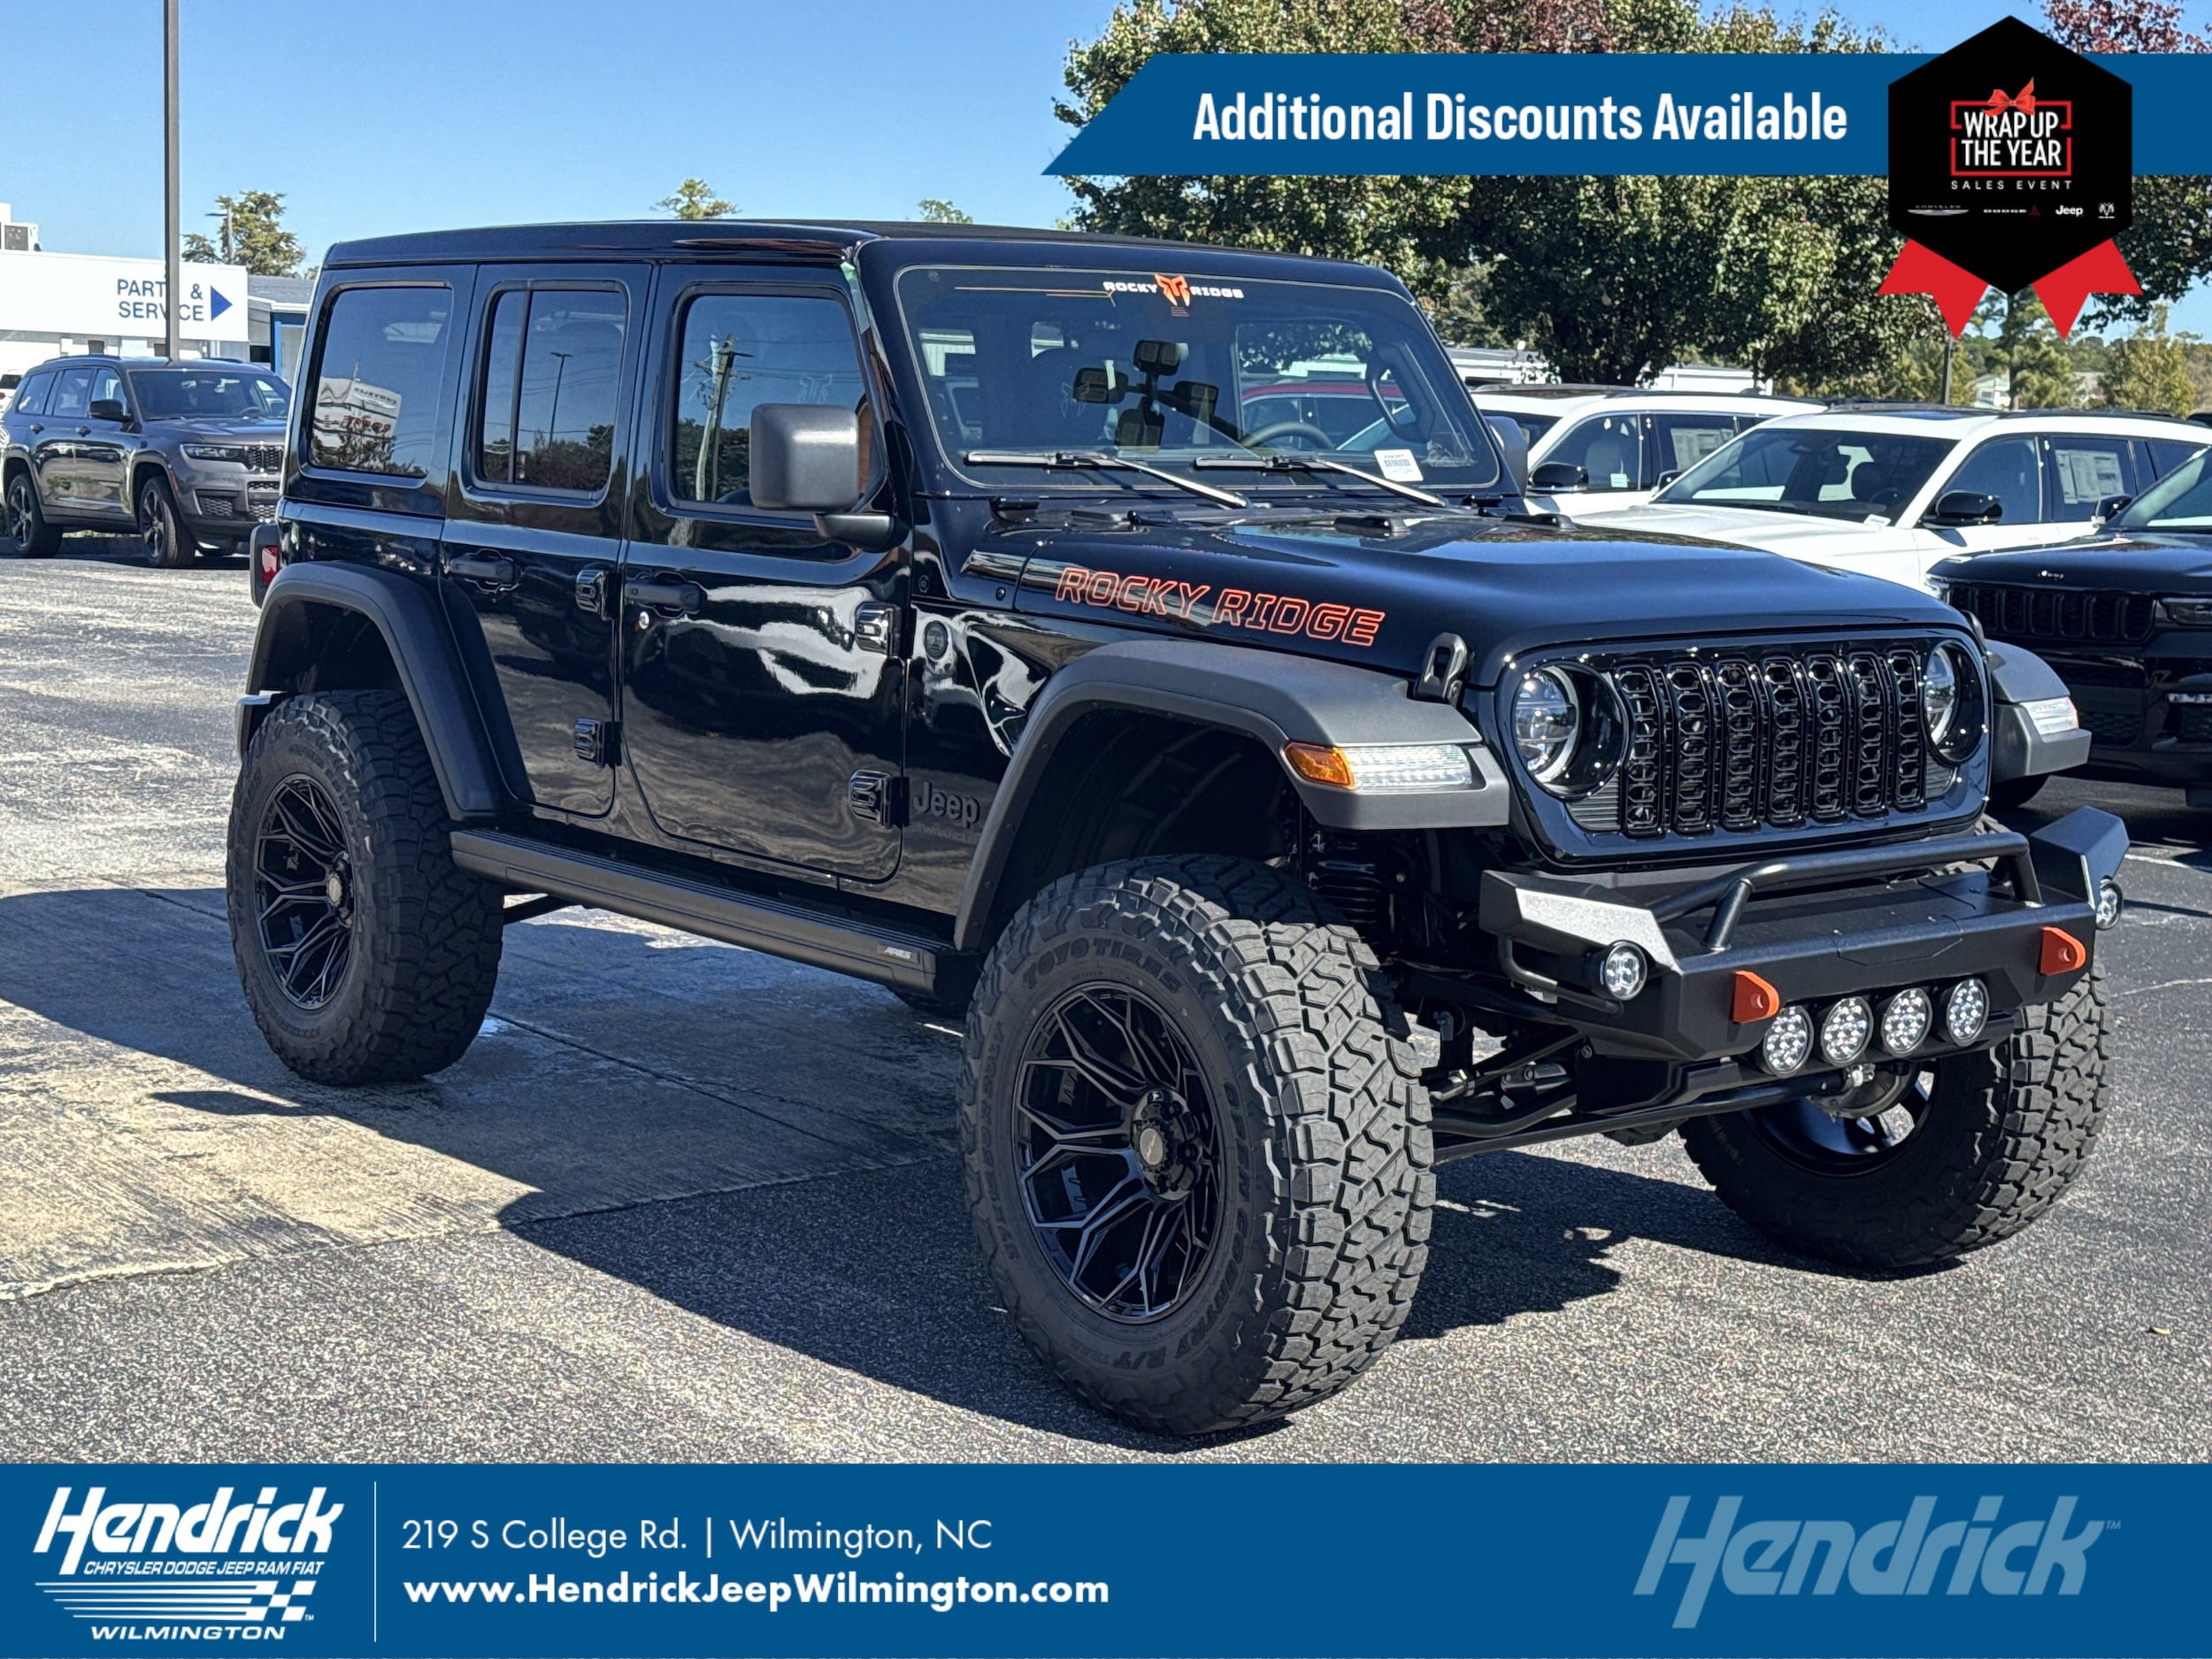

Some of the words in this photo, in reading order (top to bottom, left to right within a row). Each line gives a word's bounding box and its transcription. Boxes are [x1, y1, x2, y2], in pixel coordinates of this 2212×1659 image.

[117, 279, 168, 298] PART
[190, 282, 204, 301] &
[1102, 280, 1157, 294] ROCKY
[1189, 286, 1245, 299] RIDGE
[118, 300, 204, 322] SERVCE
[1055, 565, 1210, 620] ROCKY
[1211, 587, 1386, 648] RIDGE
[913, 780, 980, 829] Jeep
[1022, 936, 1090, 989] TOYO
[1093, 936, 1183, 994] TIRES
